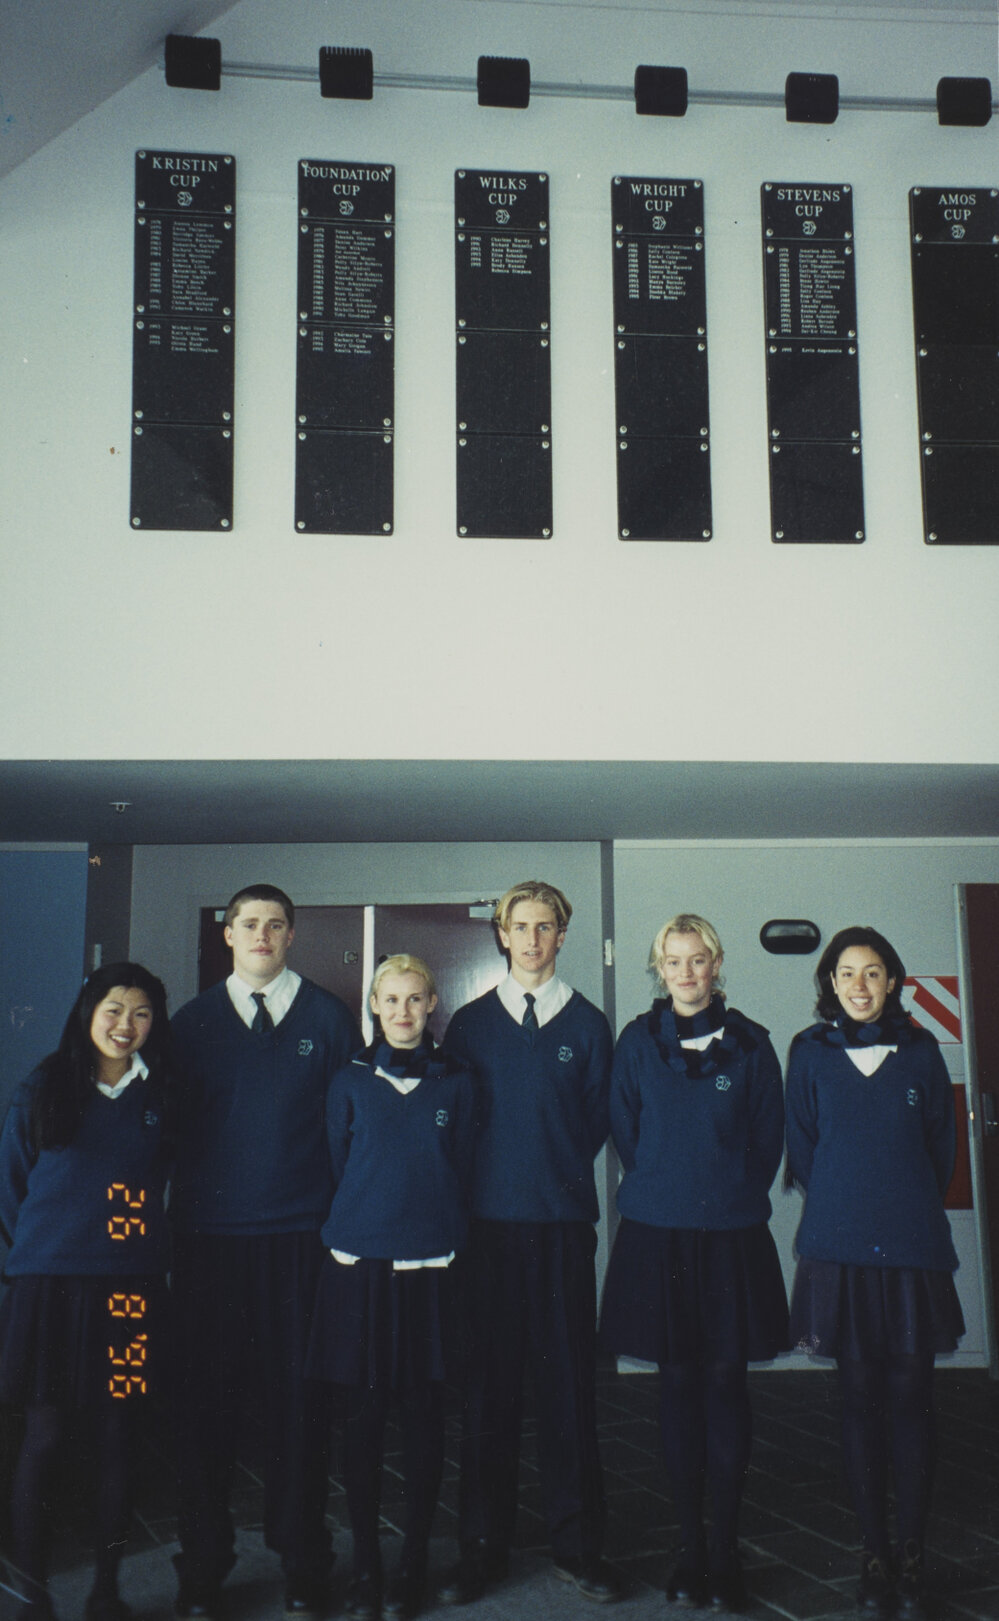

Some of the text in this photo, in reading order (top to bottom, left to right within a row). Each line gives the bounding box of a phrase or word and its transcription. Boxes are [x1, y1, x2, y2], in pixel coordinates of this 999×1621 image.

[152, 157, 219, 172] KRISTIN
[303, 166, 390, 182] FOUNDATION
[170, 175, 200, 188] CUP
[479, 176, 527, 190] WILKS
[333, 184, 360, 196] CUP
[631, 183, 687, 197] WRIGHT
[777, 189, 841, 202] STEVENS
[488, 193, 517, 205] CUP
[645, 199, 673, 212] CUP
[938, 193, 976, 205] AMOS
[795, 205, 823, 217] CUP
[944, 209, 971, 221] CUP
